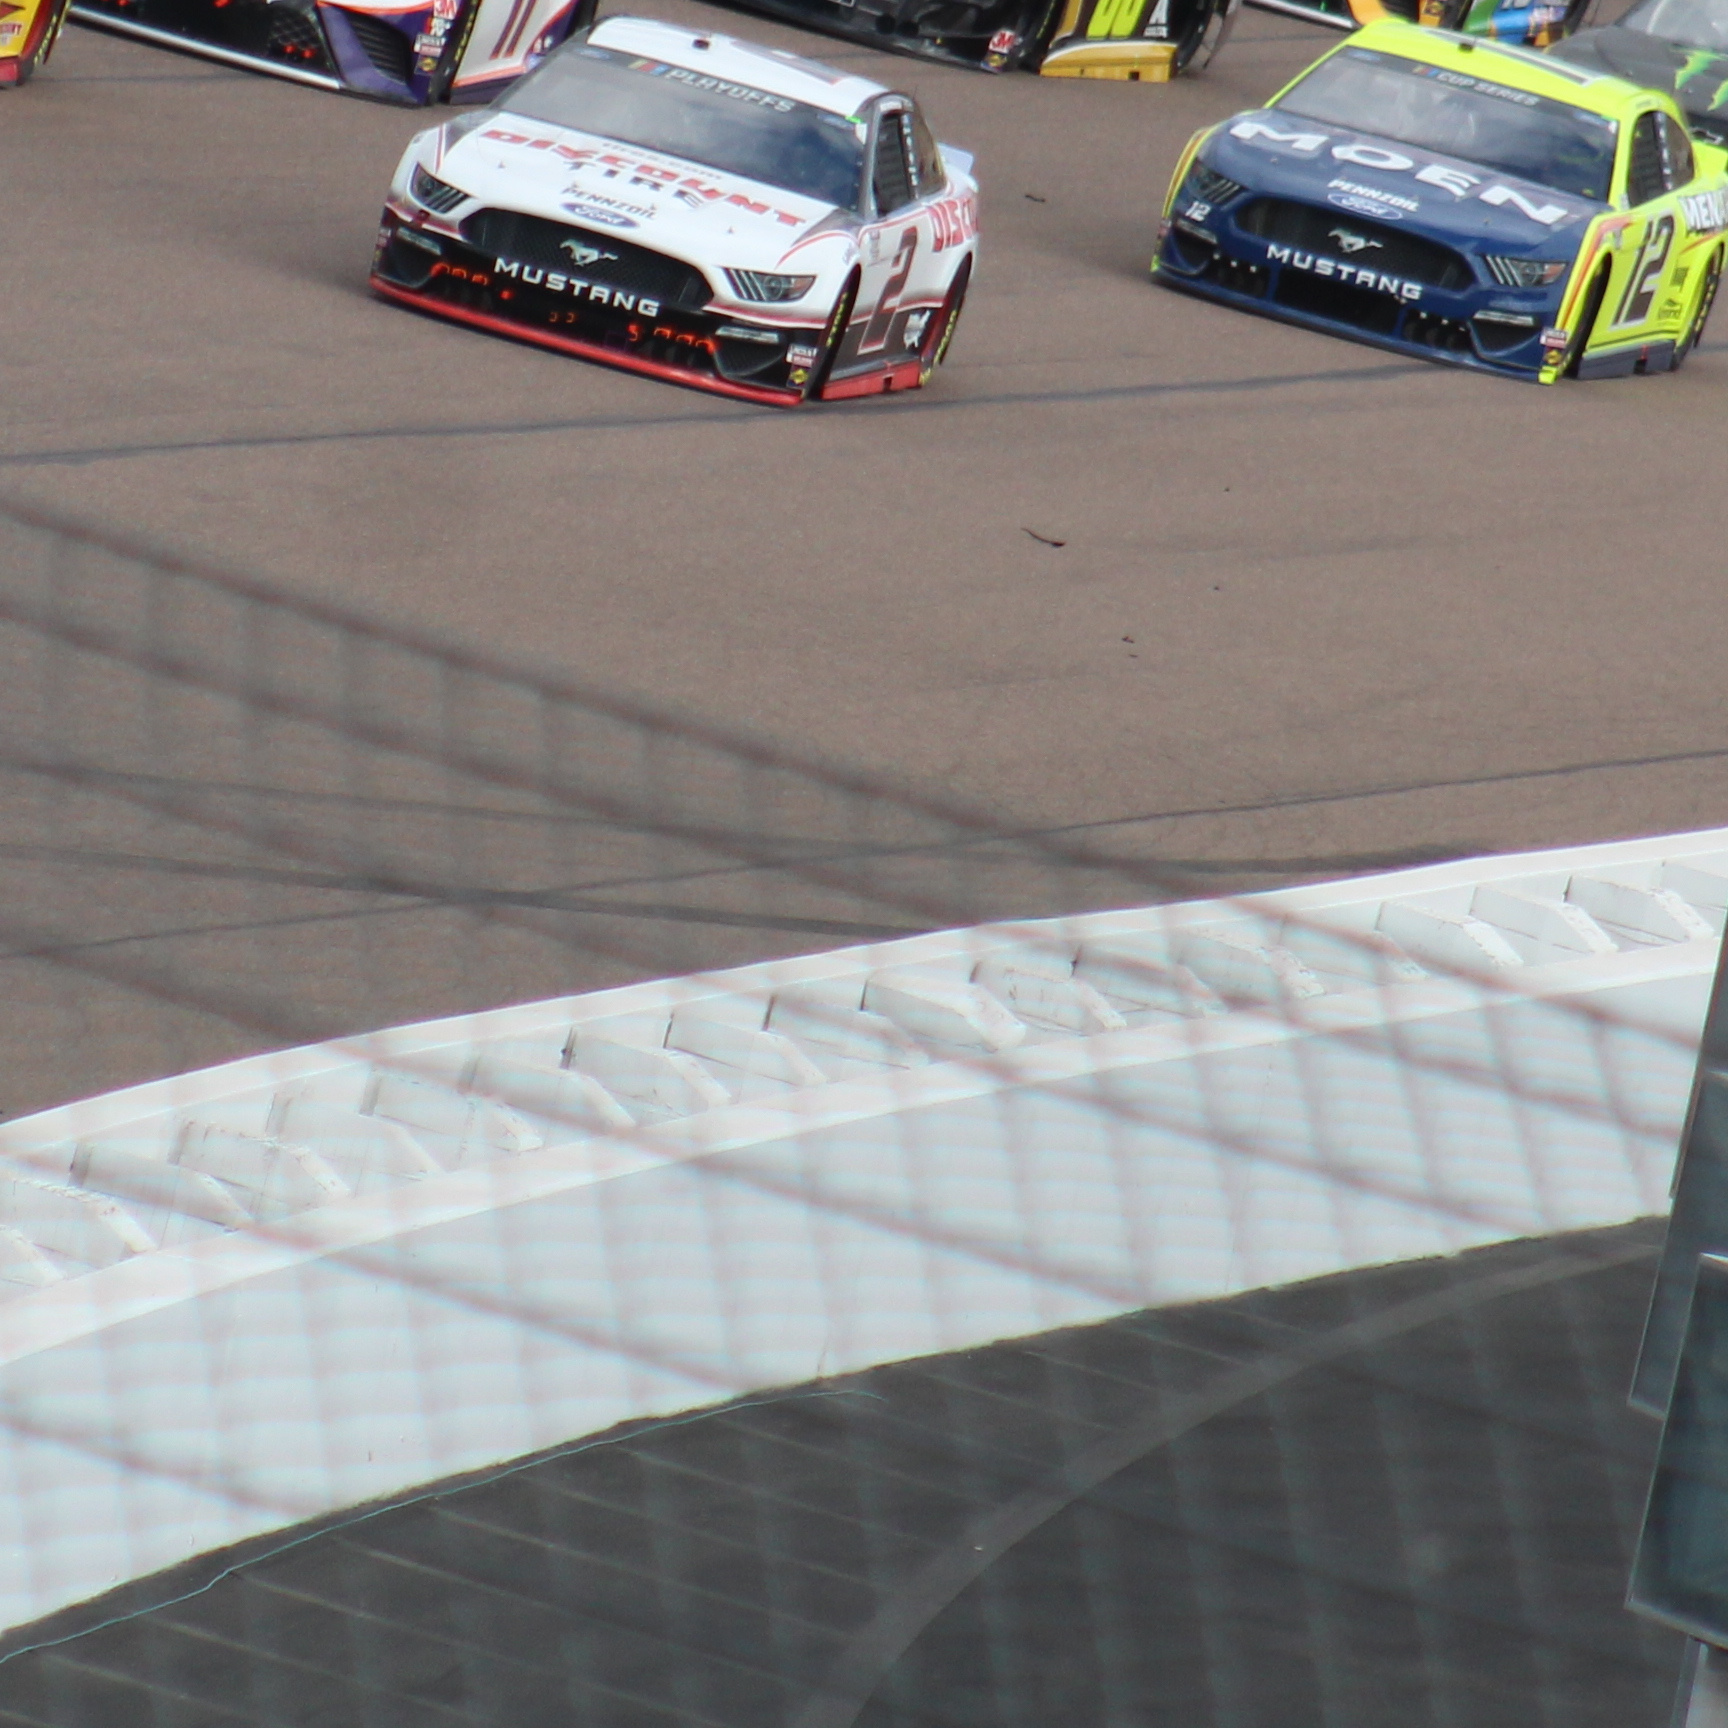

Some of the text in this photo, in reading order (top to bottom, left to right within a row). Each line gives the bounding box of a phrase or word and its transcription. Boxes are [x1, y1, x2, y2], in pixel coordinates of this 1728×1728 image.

[991, 31, 1016, 50] 3M
[665, 68, 798, 114] PLAYOFFS
[1437, 69, 1541, 107] CUP SERIES
[480, 129, 808, 229] DISCOUNT
[1228, 120, 1571, 226] MOEN
[562, 182, 659, 220] PENNZOIL
[572, 205, 624, 225] Ford
[1183, 200, 1212, 222] 12
[1327, 177, 1421, 213] PENNZOIL
[1340, 194, 1393, 217] Ford
[493, 256, 662, 318] MUSTANG
[857, 225, 919, 357] 2
[1265, 242, 1425, 301] MUSTANG
[1608, 209, 1677, 333] 12
